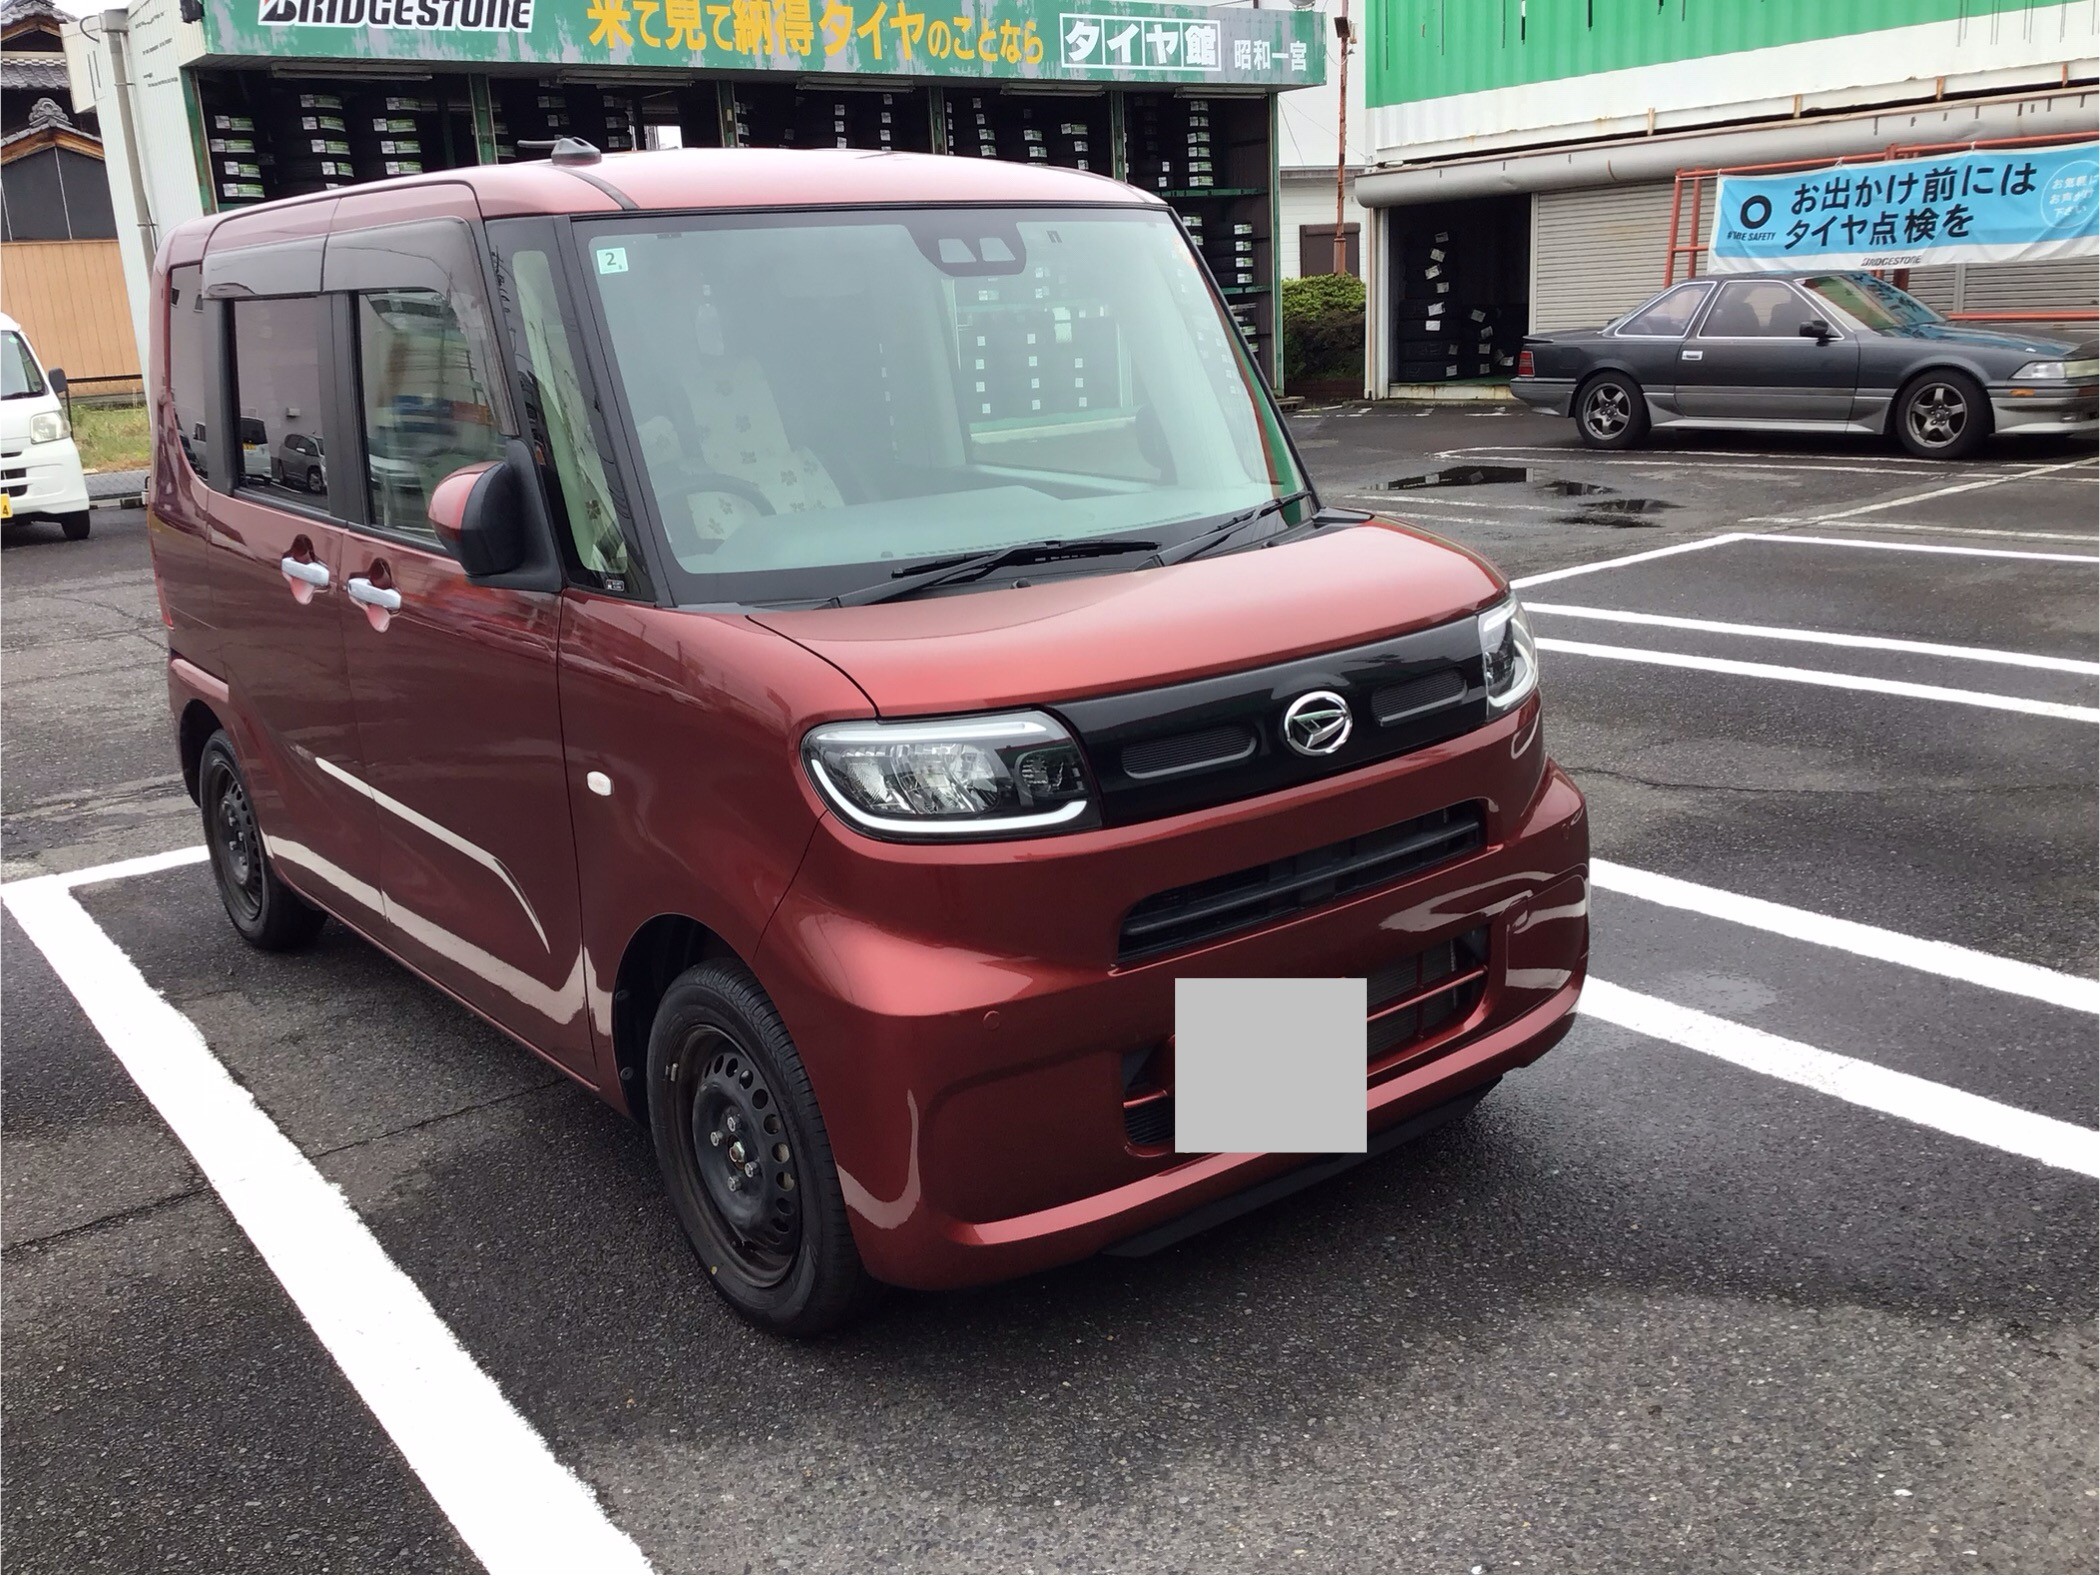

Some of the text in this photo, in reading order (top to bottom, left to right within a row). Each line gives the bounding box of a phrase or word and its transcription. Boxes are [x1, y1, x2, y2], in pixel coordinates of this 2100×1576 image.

[259, 0, 531, 30] BRIDGESTONE
[586, 0, 1044, 64] 来て見て納得タイヤのことなら
[1064, 20, 1218, 66] タイヤ館
[1234, 39, 1307, 72] 昭和一宮
[1791, 162, 2038, 216] お出かけ前には
[1748, 231, 1777, 242] SAFETY
[1784, 203, 1974, 250] タイヤ点検を
[605, 252, 617, 266] 2
[1860, 255, 1922, 267] BRIDGESTONE
